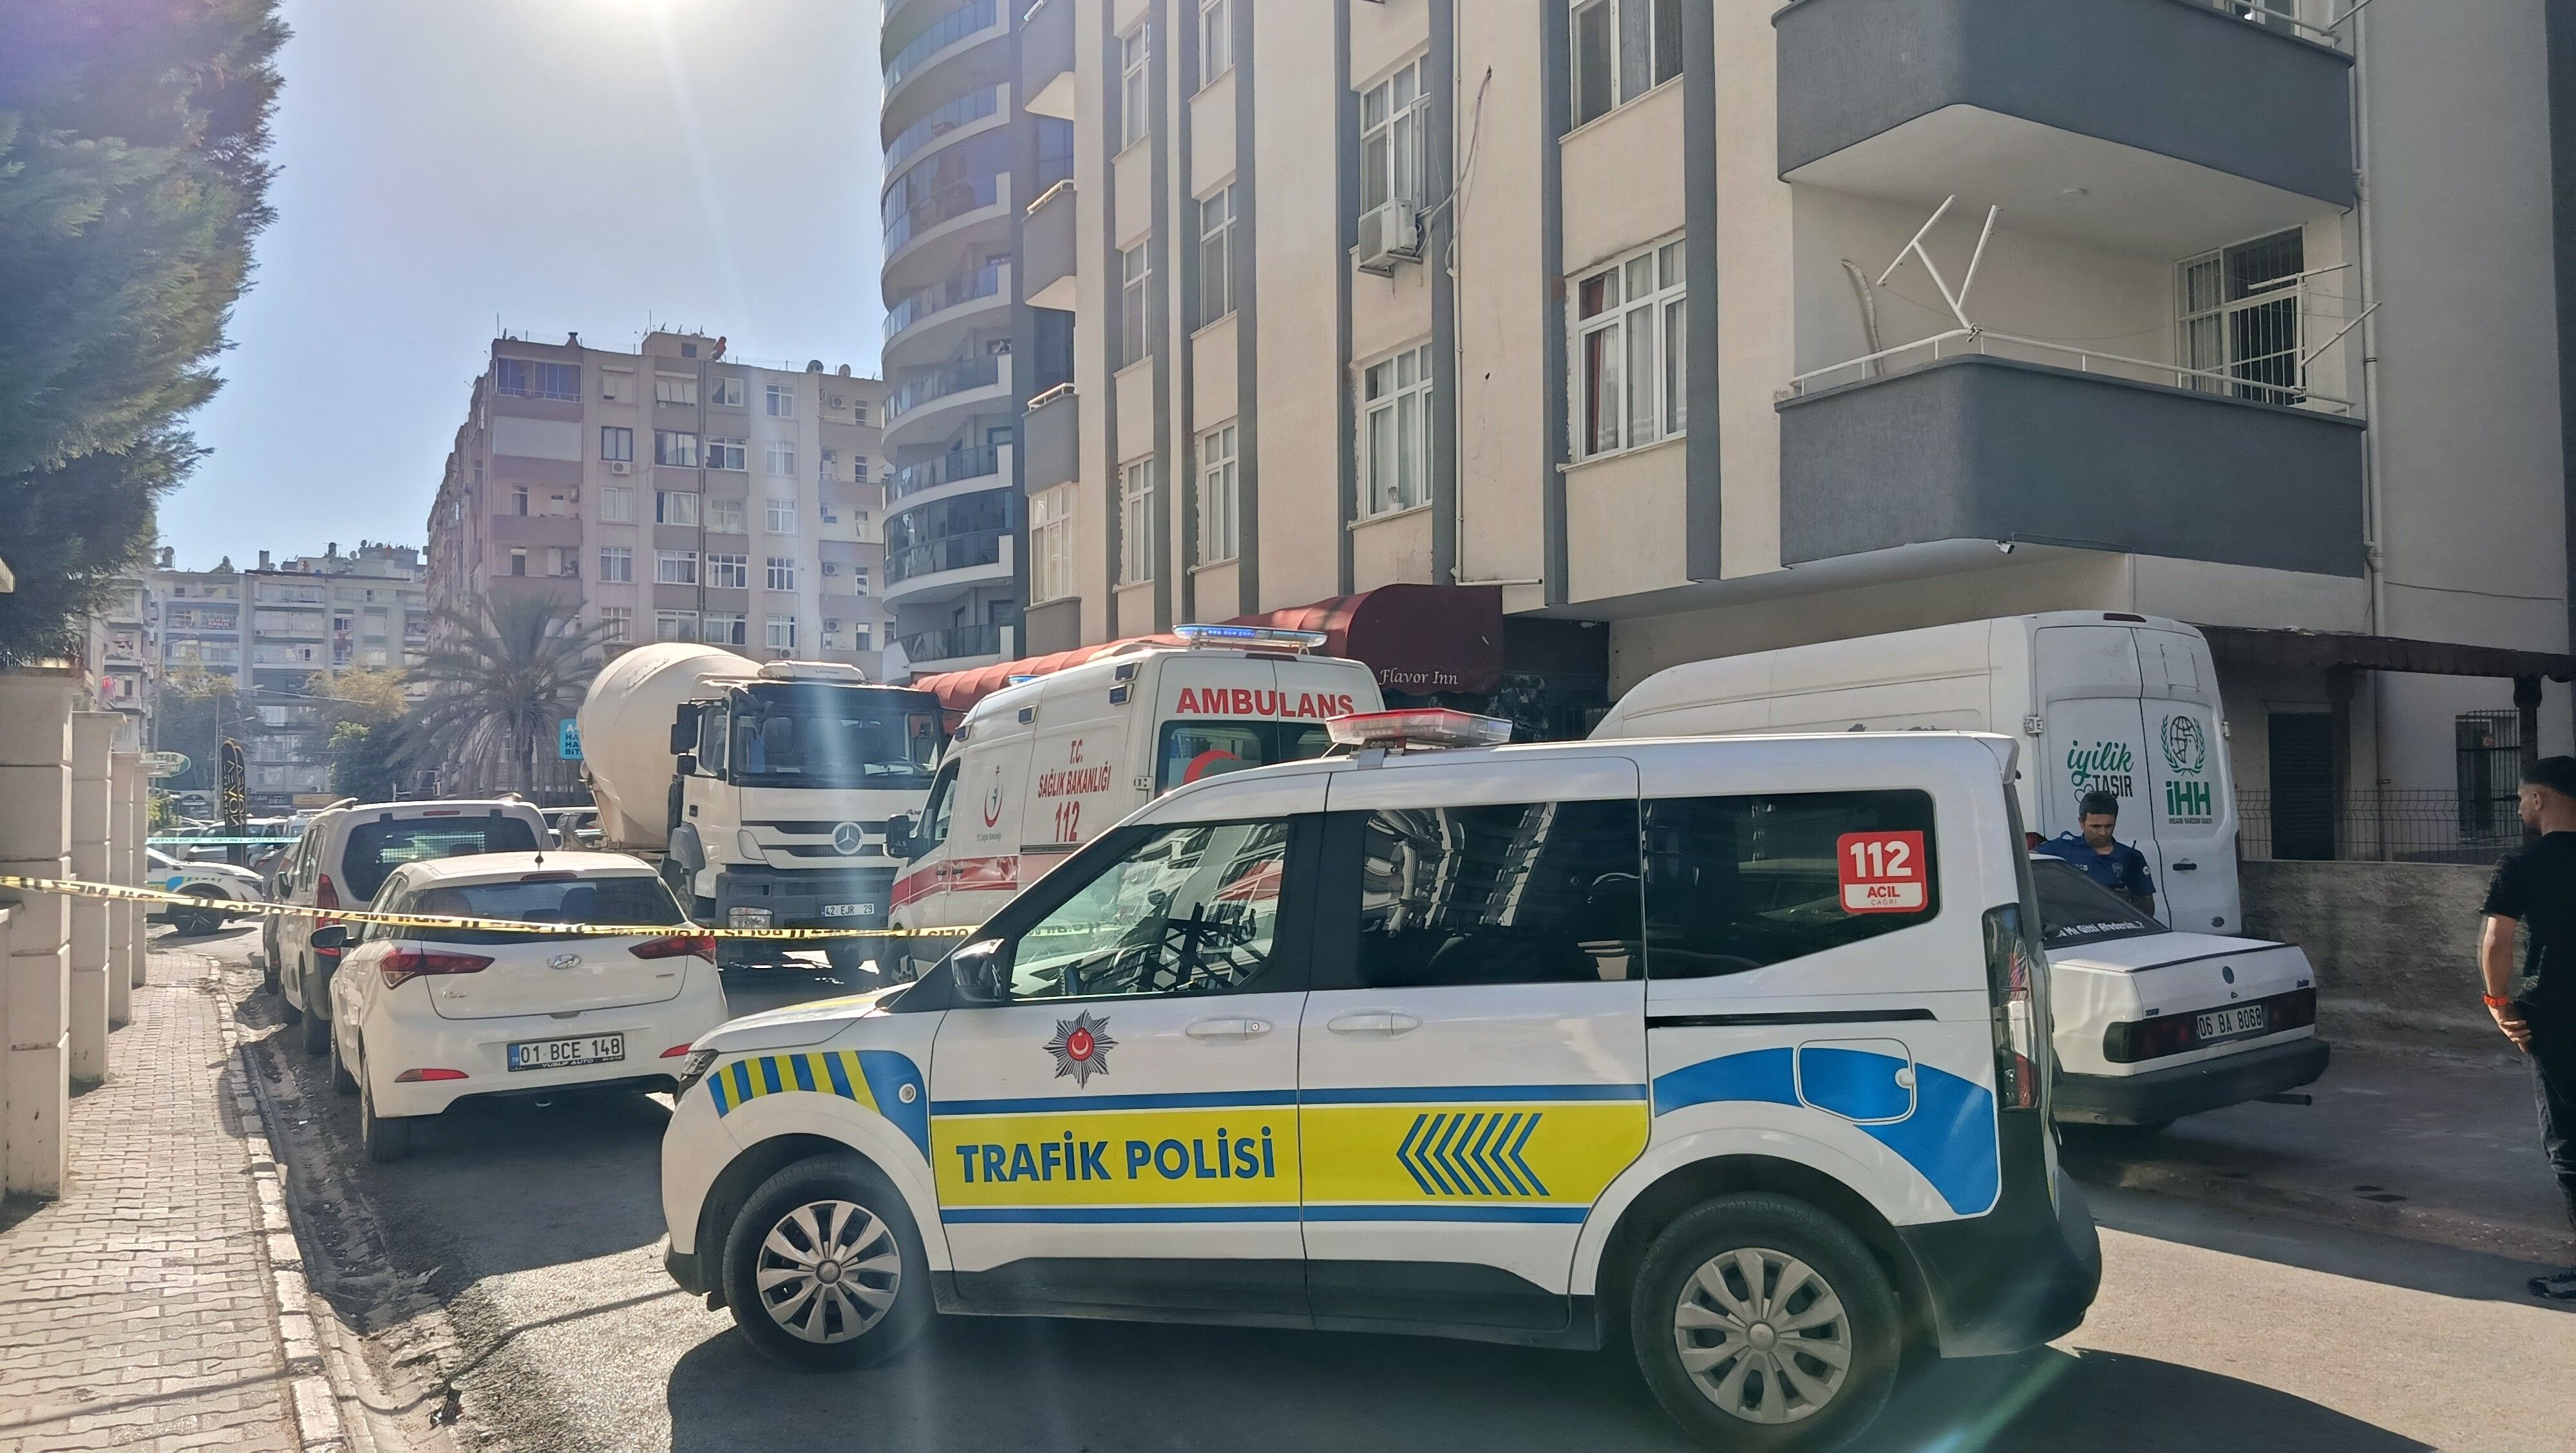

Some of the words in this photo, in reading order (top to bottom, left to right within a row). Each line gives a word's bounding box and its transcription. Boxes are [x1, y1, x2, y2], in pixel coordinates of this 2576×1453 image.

[1378, 669, 1428, 685] Flavor
[1432, 670, 1459, 685] Inn
[1176, 687, 1354, 718] AMBULANS
[1070, 739, 1083, 764] T.C.
[2067, 739, 2134, 786] iyilik
[1038, 768, 1066, 798] SAĞLIK
[1066, 761, 1112, 795] BAKANLIĞI
[1056, 801, 1080, 842] 112
[1850, 840, 1912, 878] 112
[826, 907, 835, 916] 42
[864, 904, 873, 914] 29
[2198, 1016, 2213, 1037] 06
[2218, 1013, 2233, 1034] BA
[2237, 1007, 2262, 1030] 8068
[520, 1045, 540, 1063] 01
[550, 1041, 582, 1061] BCE
[591, 1038, 621, 1056] 148
[956, 1130, 1112, 1184] TRAFİK
[1125, 1125, 1276, 1181] POLİSİ
